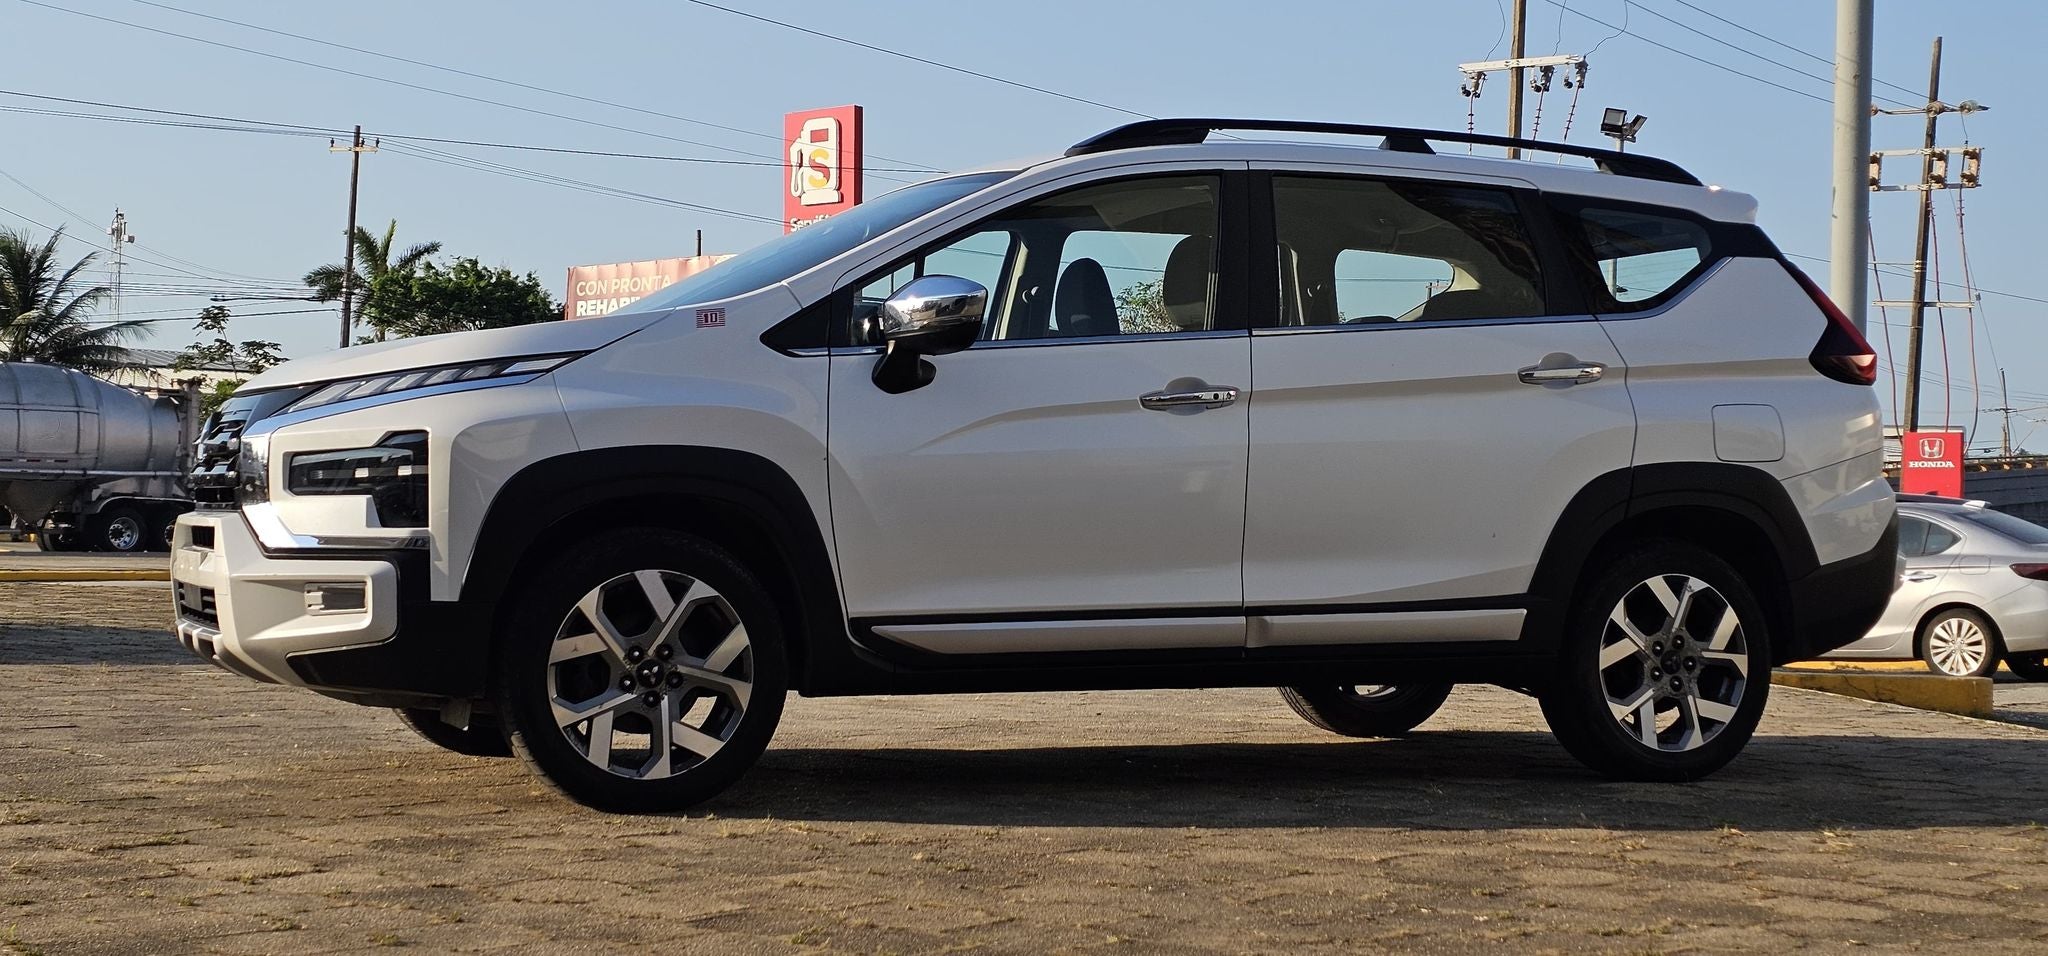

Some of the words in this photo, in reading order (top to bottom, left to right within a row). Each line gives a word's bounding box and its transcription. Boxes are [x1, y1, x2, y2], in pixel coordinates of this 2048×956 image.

[809, 148, 830, 188] S
[576, 279, 607, 297] CON
[611, 274, 671, 294] PRONTA
[703, 312, 718, 323] 10
[1909, 460, 1955, 468] HONDA
